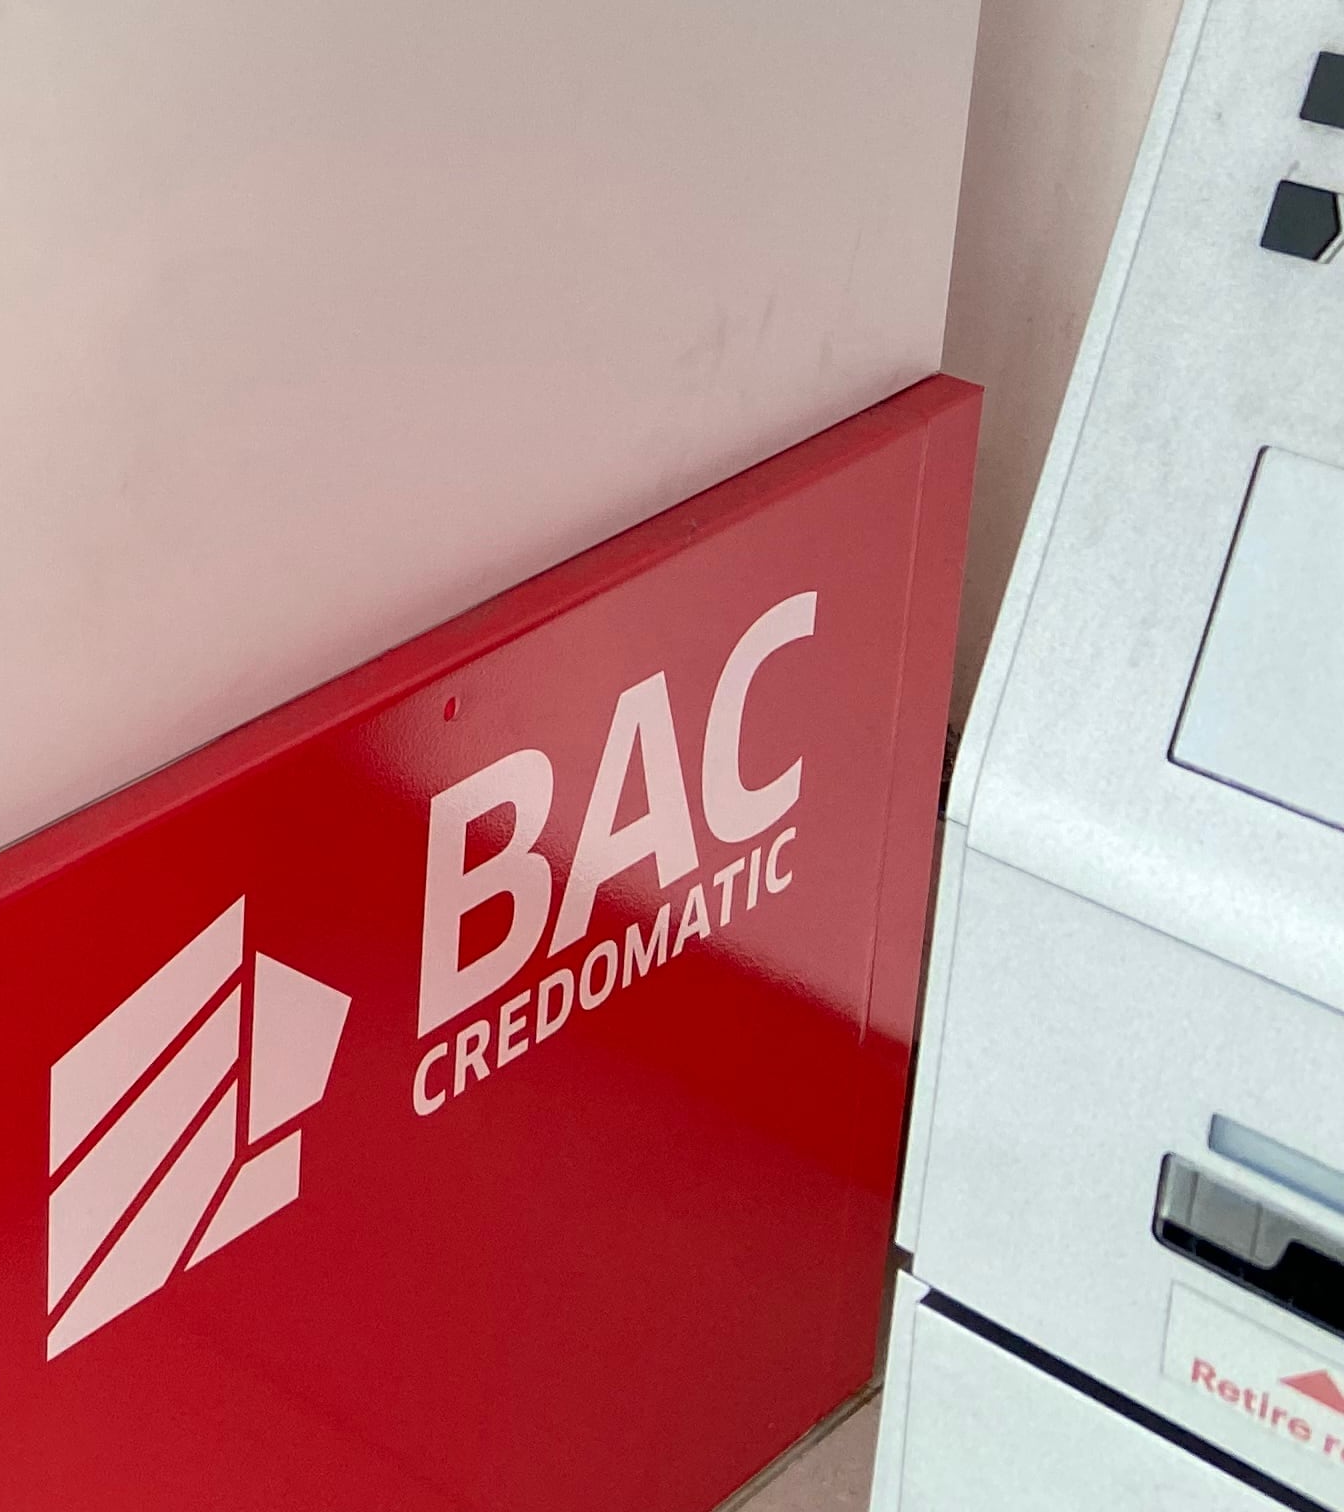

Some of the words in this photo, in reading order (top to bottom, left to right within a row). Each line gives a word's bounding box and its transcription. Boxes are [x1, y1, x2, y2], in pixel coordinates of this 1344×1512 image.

[418, 590, 819, 1040] BAC
[412, 826, 799, 1118] CREDOMATIC
[1190, 1356, 1312, 1443] Retire
[1323, 1433, 1344, 1466] r
